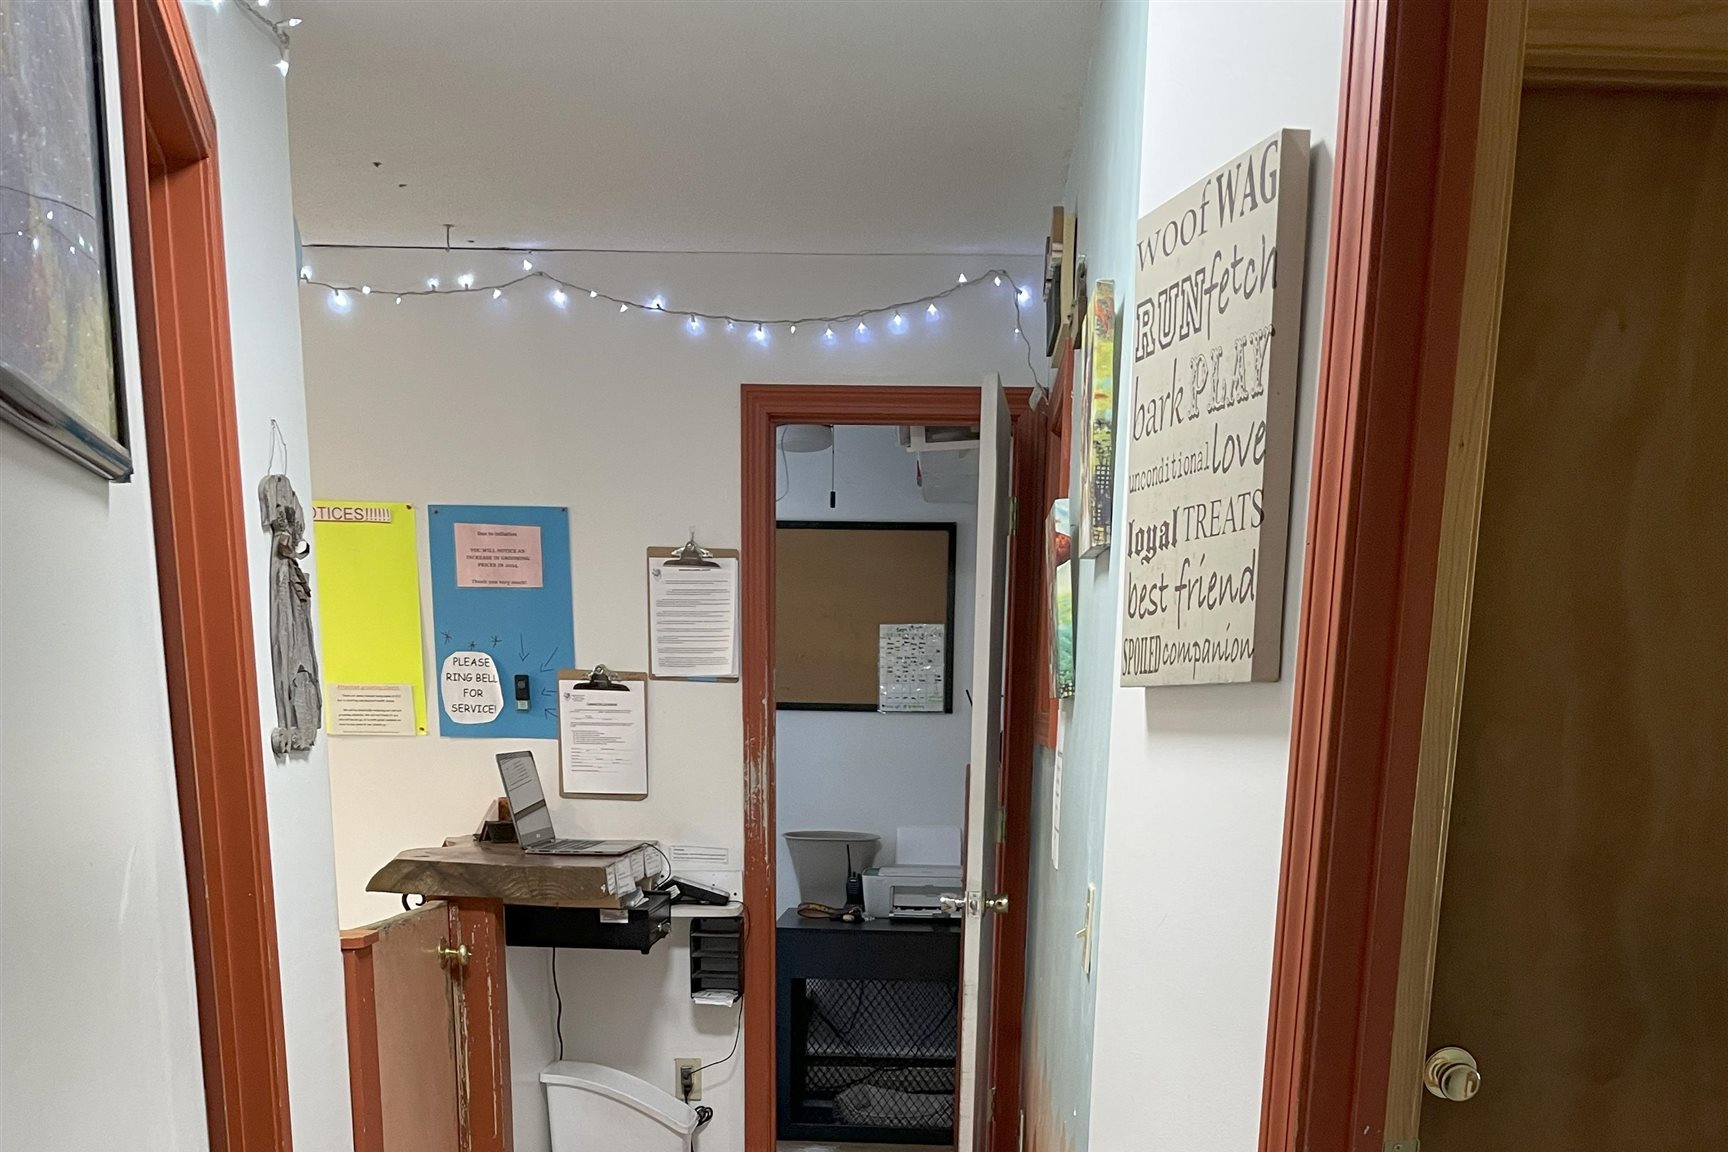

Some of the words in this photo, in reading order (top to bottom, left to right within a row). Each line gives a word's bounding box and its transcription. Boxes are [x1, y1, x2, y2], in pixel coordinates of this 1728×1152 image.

[1215, 140, 1278, 228] WAG
[1135, 266, 1207, 363] RUN
[1204, 234, 1277, 340] fetch
[1133, 358, 1184, 441] bark
[1187, 324, 1275, 421] PLAY
[1128, 441, 1210, 493] unconditional
[1211, 419, 1266, 475] love
[1127, 505, 1179, 565] loyal
[1183, 488, 1265, 542] TREATS
[1128, 572, 1168, 619] best
[1174, 548, 1256, 630] friend
[446, 672, 473, 682] RING
[475, 673, 498, 684] BELL
[452, 656, 490, 668] PLEASE
[1121, 635, 1161, 677] SPOILED
[1162, 623, 1254, 680] companion
[451, 703, 497, 714] SERVICE!
[463, 688, 484, 698] FOR
